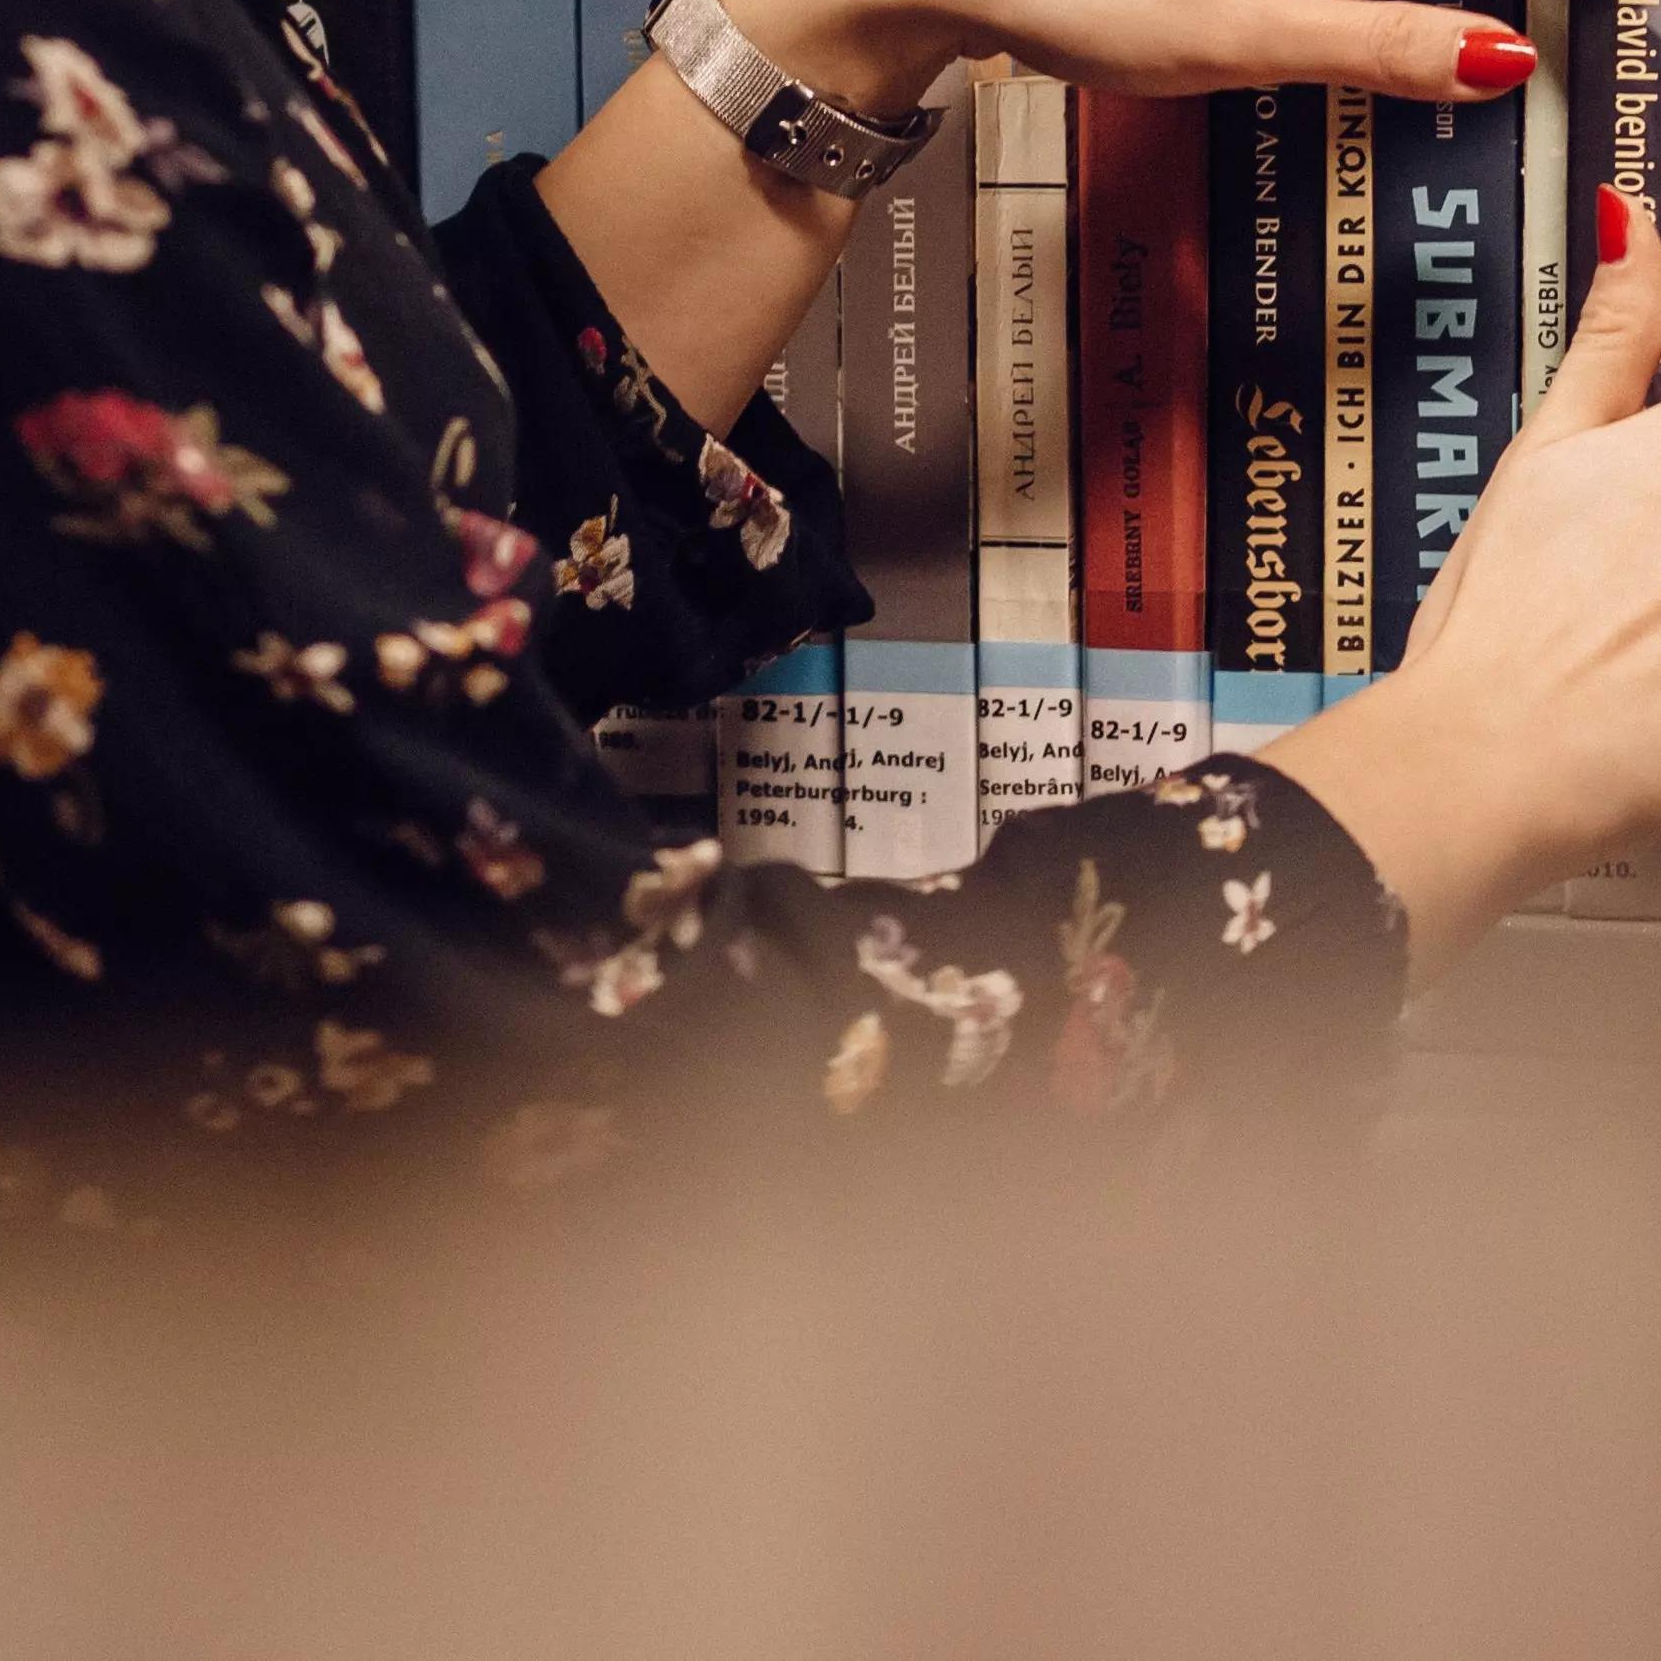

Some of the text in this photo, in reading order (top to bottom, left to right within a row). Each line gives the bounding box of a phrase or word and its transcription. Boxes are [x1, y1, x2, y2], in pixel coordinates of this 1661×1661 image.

[1254, 130, 1280, 346] ANN BENDER
[1337, 214, 1366, 284] DER
[892, 196, 917, 454] АНДРЕЙ БЕЛЫЙ
[1337, 302, 1366, 369] BIN
[1538, 261, 1560, 350] GŁĘBIA
[1337, 387, 1366, 444] ICH
[1234, 383, 1304, 675] Lebensbor
[1337, 488, 1366, 652] BELZNER
[871, 749, 946, 773] Andrej
[1090, 719, 1188, 745] 82-1/-9
[1090, 763, 1145, 786] Belyj,
[737, 808, 797, 828] 1994.
